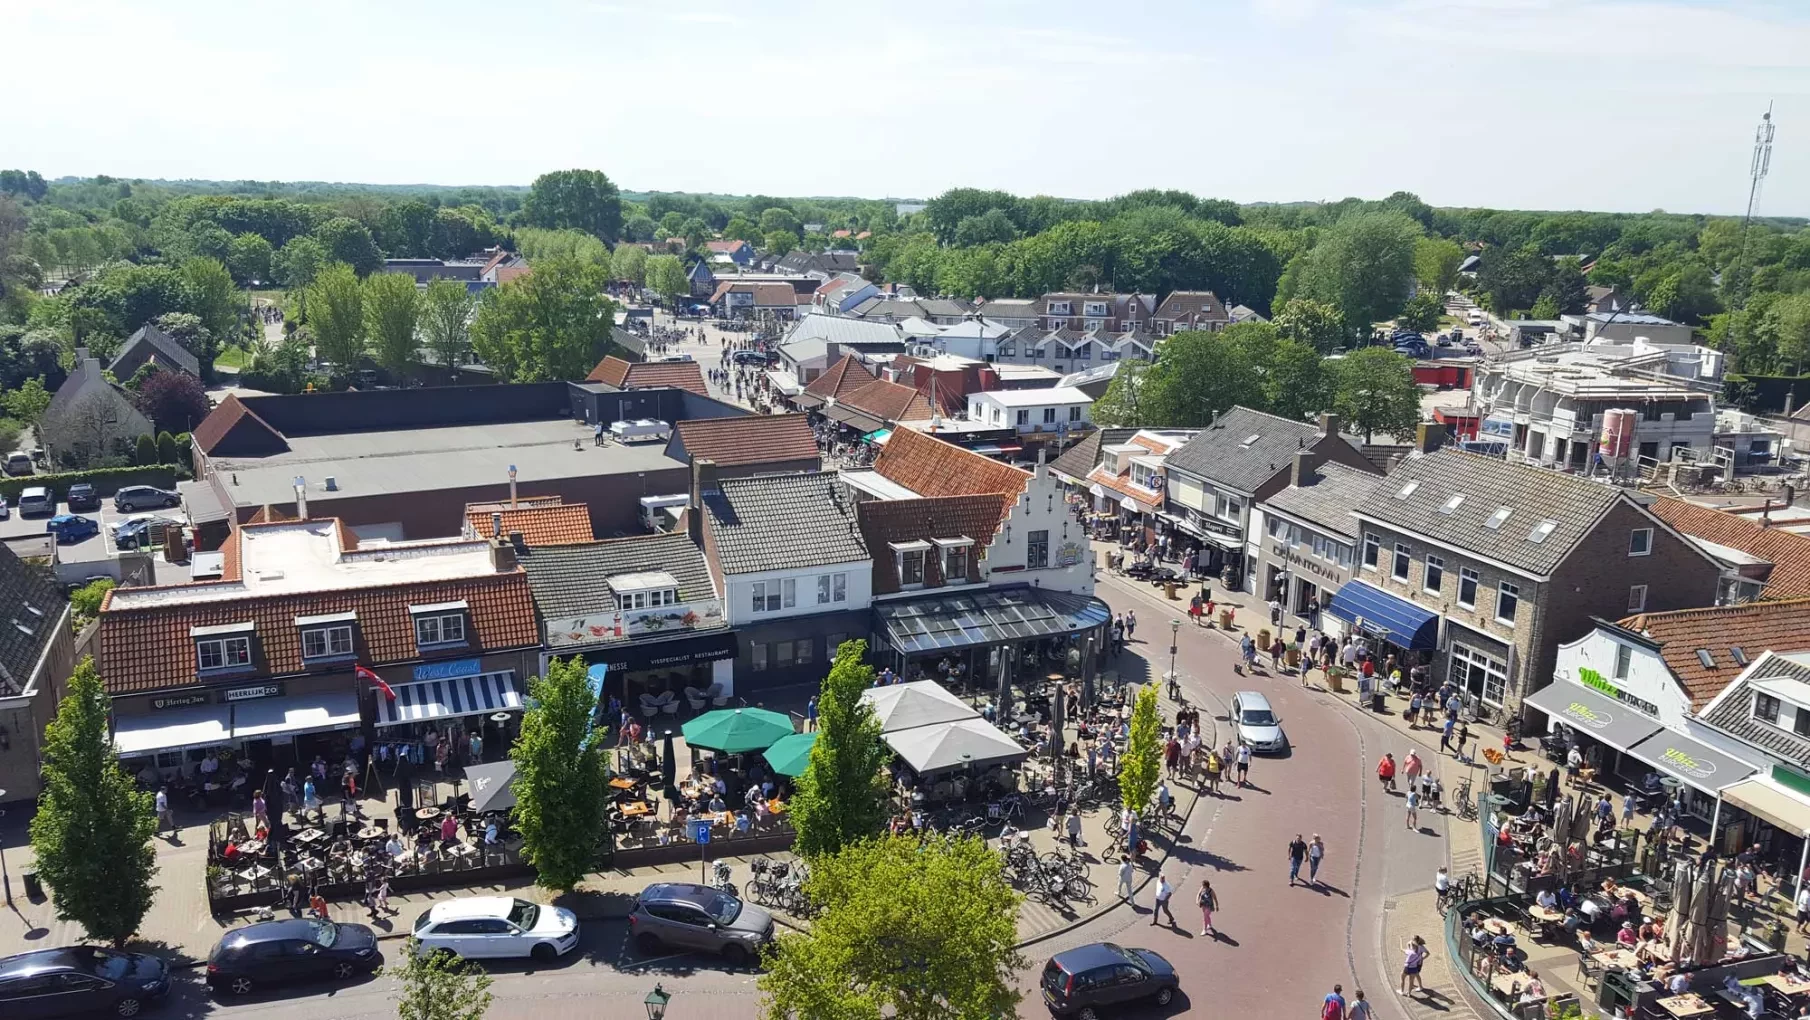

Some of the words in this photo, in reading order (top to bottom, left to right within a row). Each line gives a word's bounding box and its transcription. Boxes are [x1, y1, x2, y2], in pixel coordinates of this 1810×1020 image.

[650, 654, 690, 664] VISSPECIALIST
[694, 649, 729, 658] RESTAURANT
[607, 661, 628, 672] ENESSE
[228, 687, 264, 699] HEERLIJK
[264, 686, 278, 694] ZO
[700, 827, 707, 837] P
